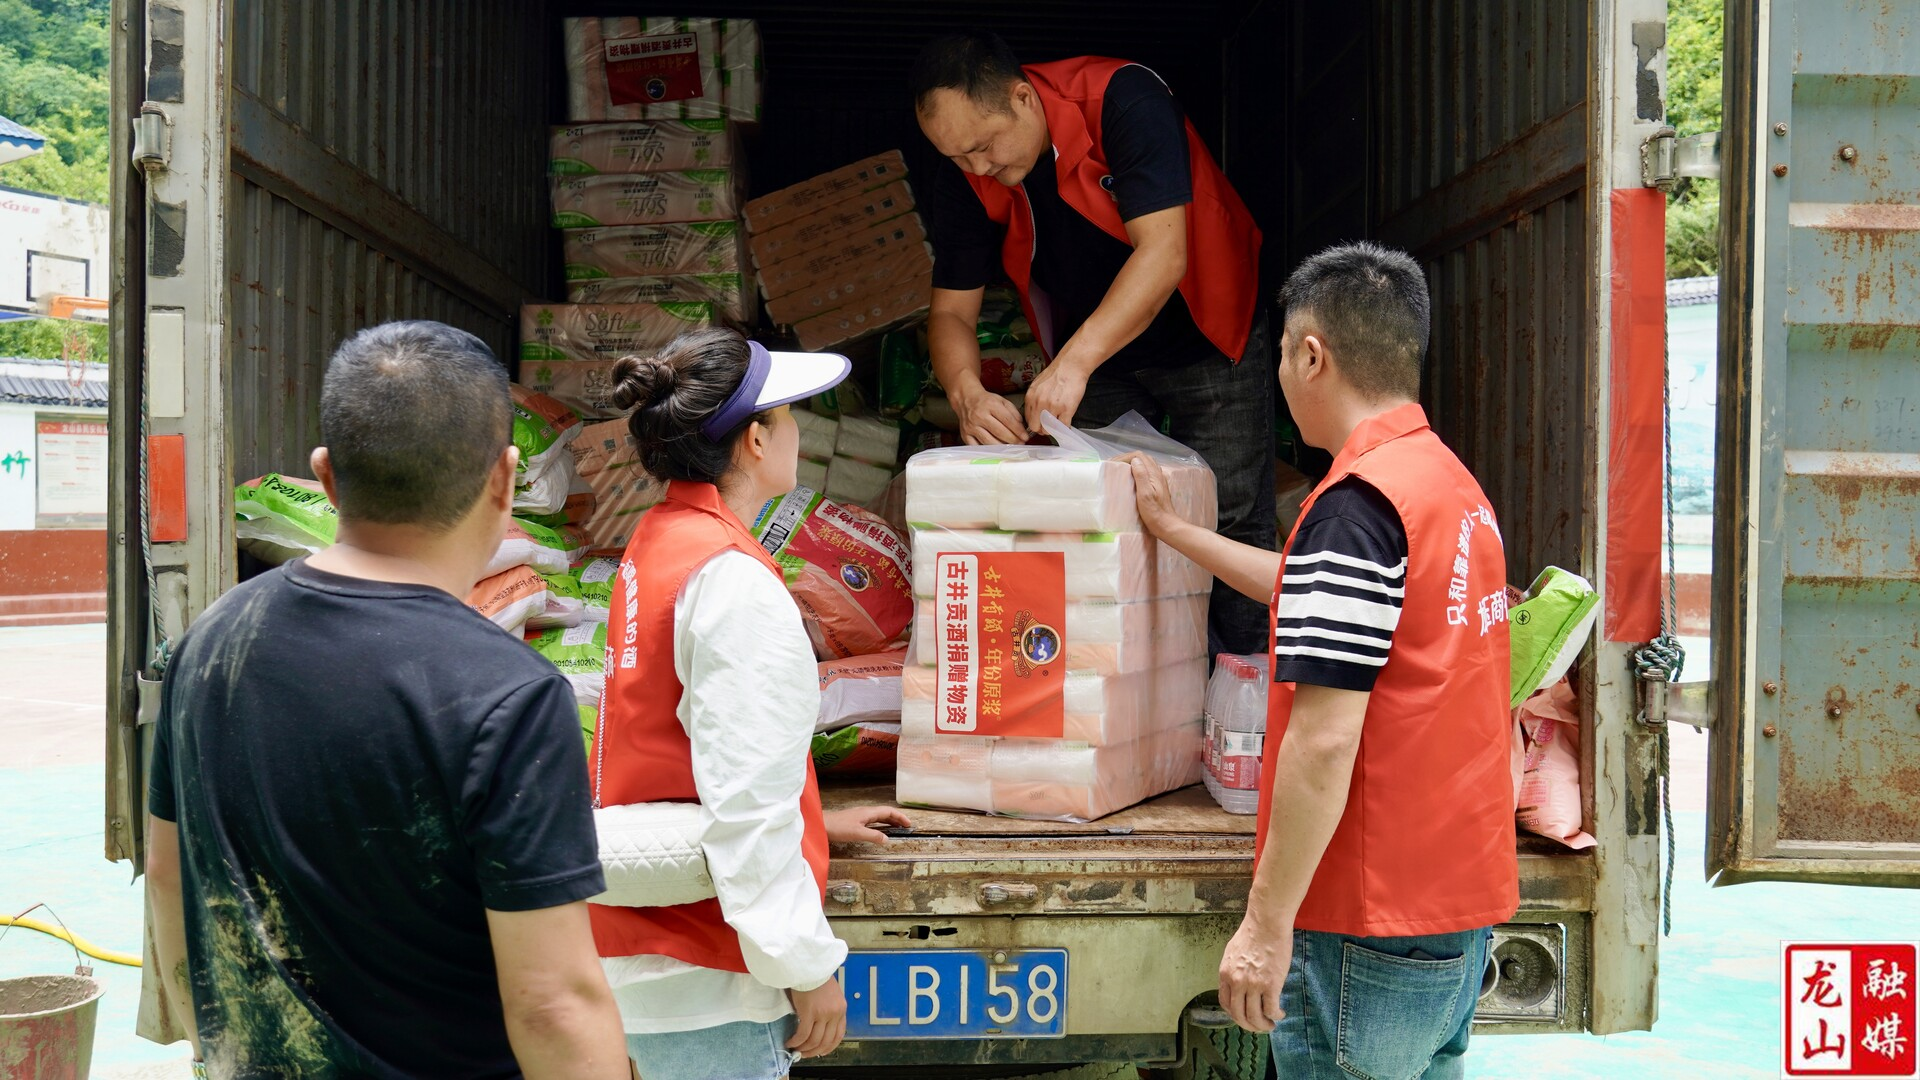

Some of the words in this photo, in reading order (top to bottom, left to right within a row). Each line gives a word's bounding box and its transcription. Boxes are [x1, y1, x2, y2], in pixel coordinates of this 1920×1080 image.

[609, 37, 693, 57] 古井贡酒捐赠物资
[585, 312, 624, 334] Soft
[822, 503, 913, 576] 井贡酒捐赠物资
[620, 558, 639, 669] 喝健康的酒
[946, 560, 969, 725] 古井贡酒捐赠物资
[979, 565, 1005, 716] 古井贡酒·年份原浆
[837, 964, 1058, 1025] ·LB158
